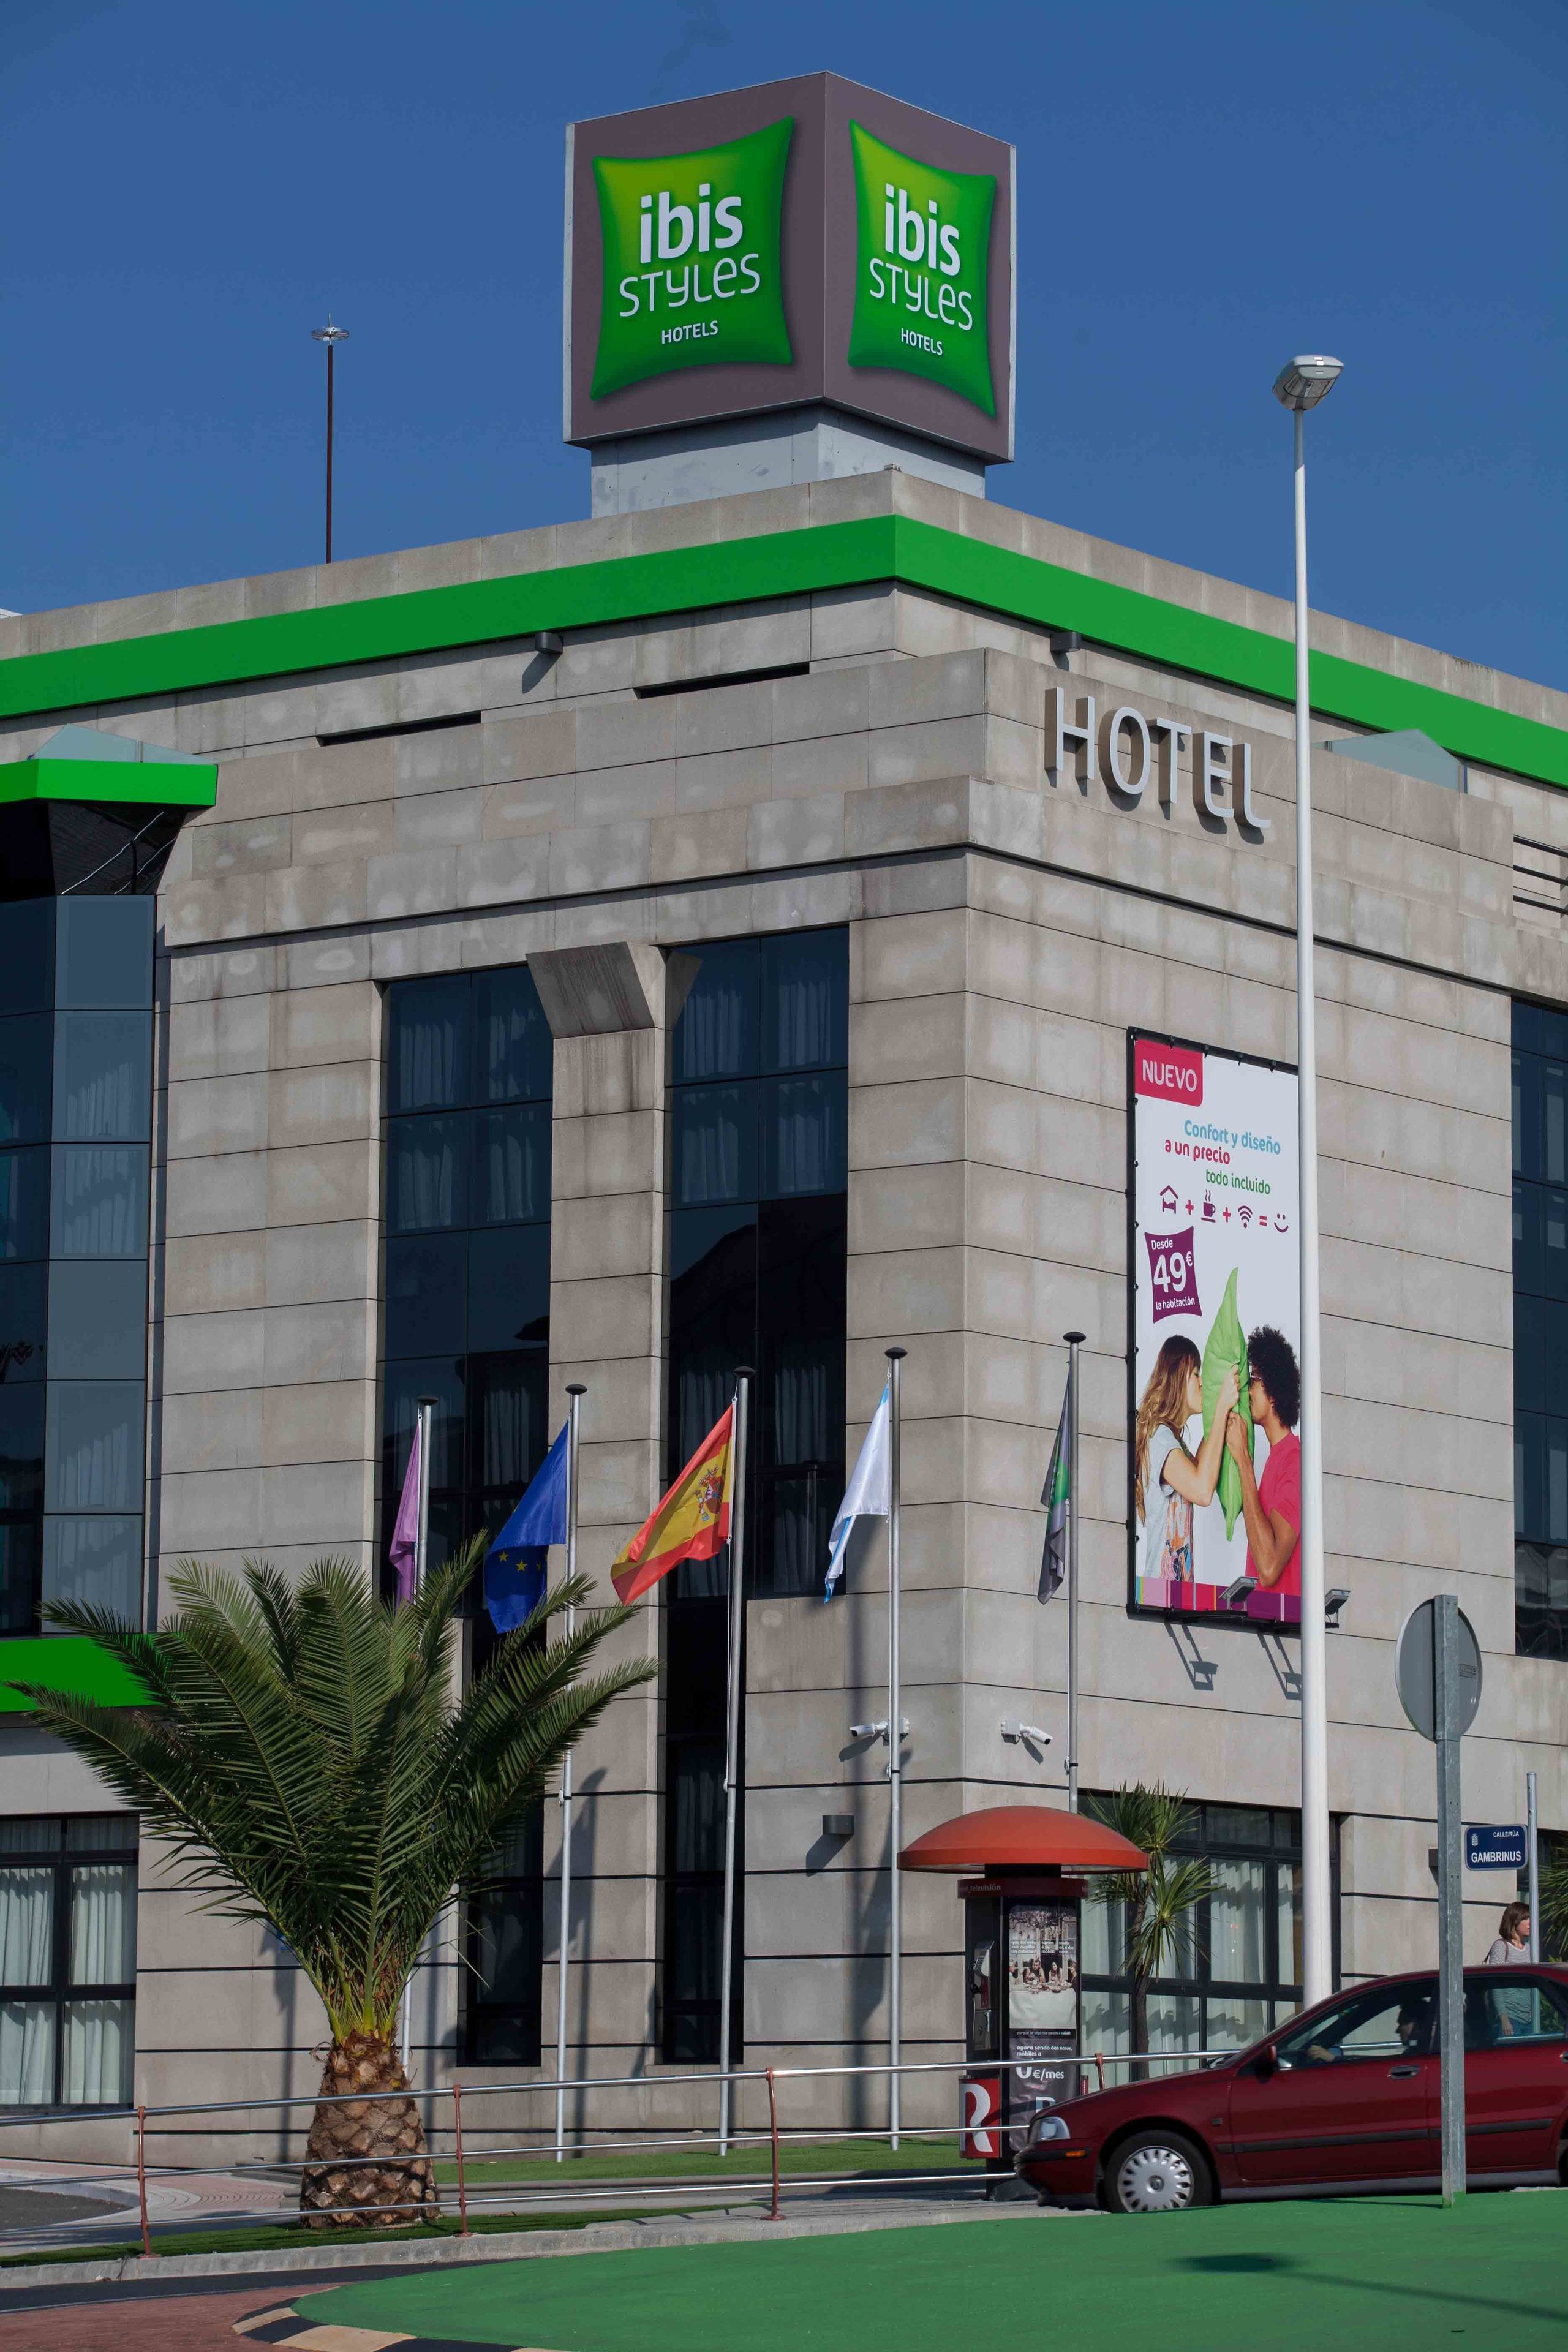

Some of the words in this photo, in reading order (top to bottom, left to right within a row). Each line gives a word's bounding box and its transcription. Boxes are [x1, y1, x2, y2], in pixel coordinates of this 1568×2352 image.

[640, 183, 743, 263] ibis
[885, 183, 961, 276] ibis
[661, 320, 718, 345] HOTELS
[900, 328, 943, 356] HOTELS
[1045, 687, 1271, 829] HOTEL
[1142, 1058, 1197, 1093] NUEVO
[1184, 1119, 1229, 1144] Confort
[1231, 1133, 1238, 1148] y
[1241, 1131, 1281, 1155] diseño
[1164, 1139, 1172, 1153] a
[1175, 1142, 1190, 1157] un
[1193, 1145, 1231, 1165] precio
[1205, 1169, 1229, 1187] todo
[1231, 1172, 1271, 1195] incluido
[1151, 1238, 1174, 1250] Desde
[1155, 1300, 1161, 1310] la
[1162, 1295, 1196, 1308] habitación
[1471, 1851, 1521, 1863] GAMBRINUS
